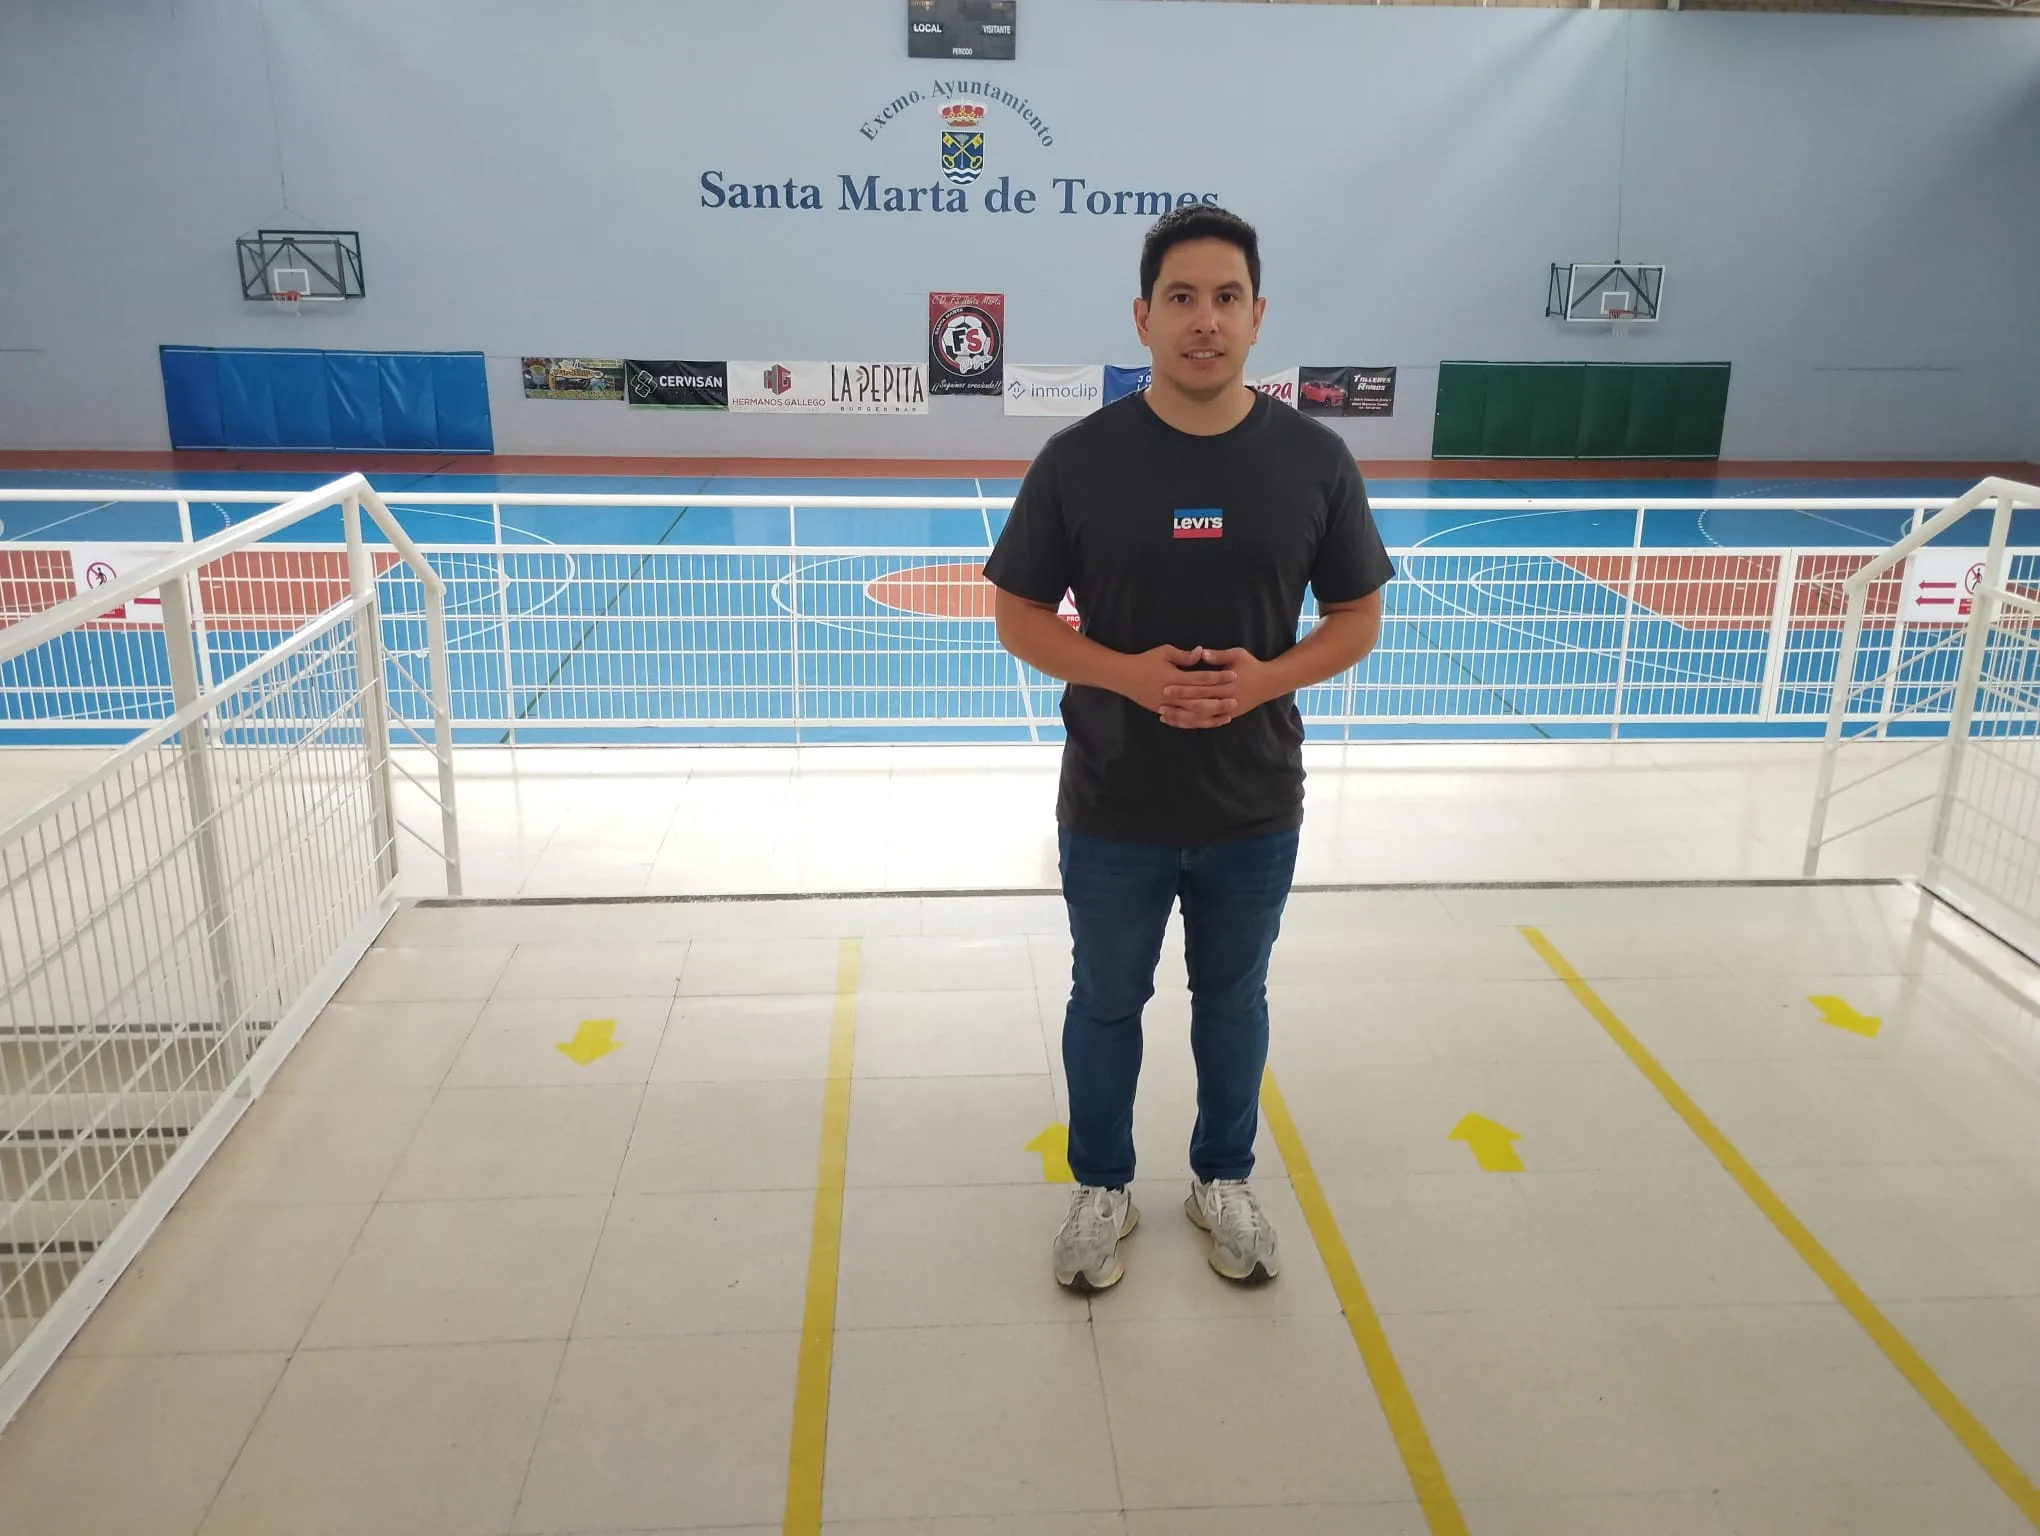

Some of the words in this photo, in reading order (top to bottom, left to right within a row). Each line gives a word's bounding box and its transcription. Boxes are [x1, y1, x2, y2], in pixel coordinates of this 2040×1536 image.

[913, 24, 942, 33] LOCAL
[982, 25, 1011, 34] VISITANTE
[859, 90, 926, 142] Excmo.
[931, 79, 1053, 147] Ayuntamiento
[700, 170, 823, 210] Santa
[837, 175, 968, 212] Marta
[984, 176, 1037, 214] de
[1052, 178, 1218, 216] Tormes
[952, 327, 983, 354] FS
[659, 375, 723, 388] CERVISÁN
[831, 364, 852, 402] LA
[857, 364, 924, 403] PEPITA
[1031, 384, 1098, 400] inmoclip
[732, 398, 783, 406] HERMANOS
[784, 399, 826, 407] GALLEGO
